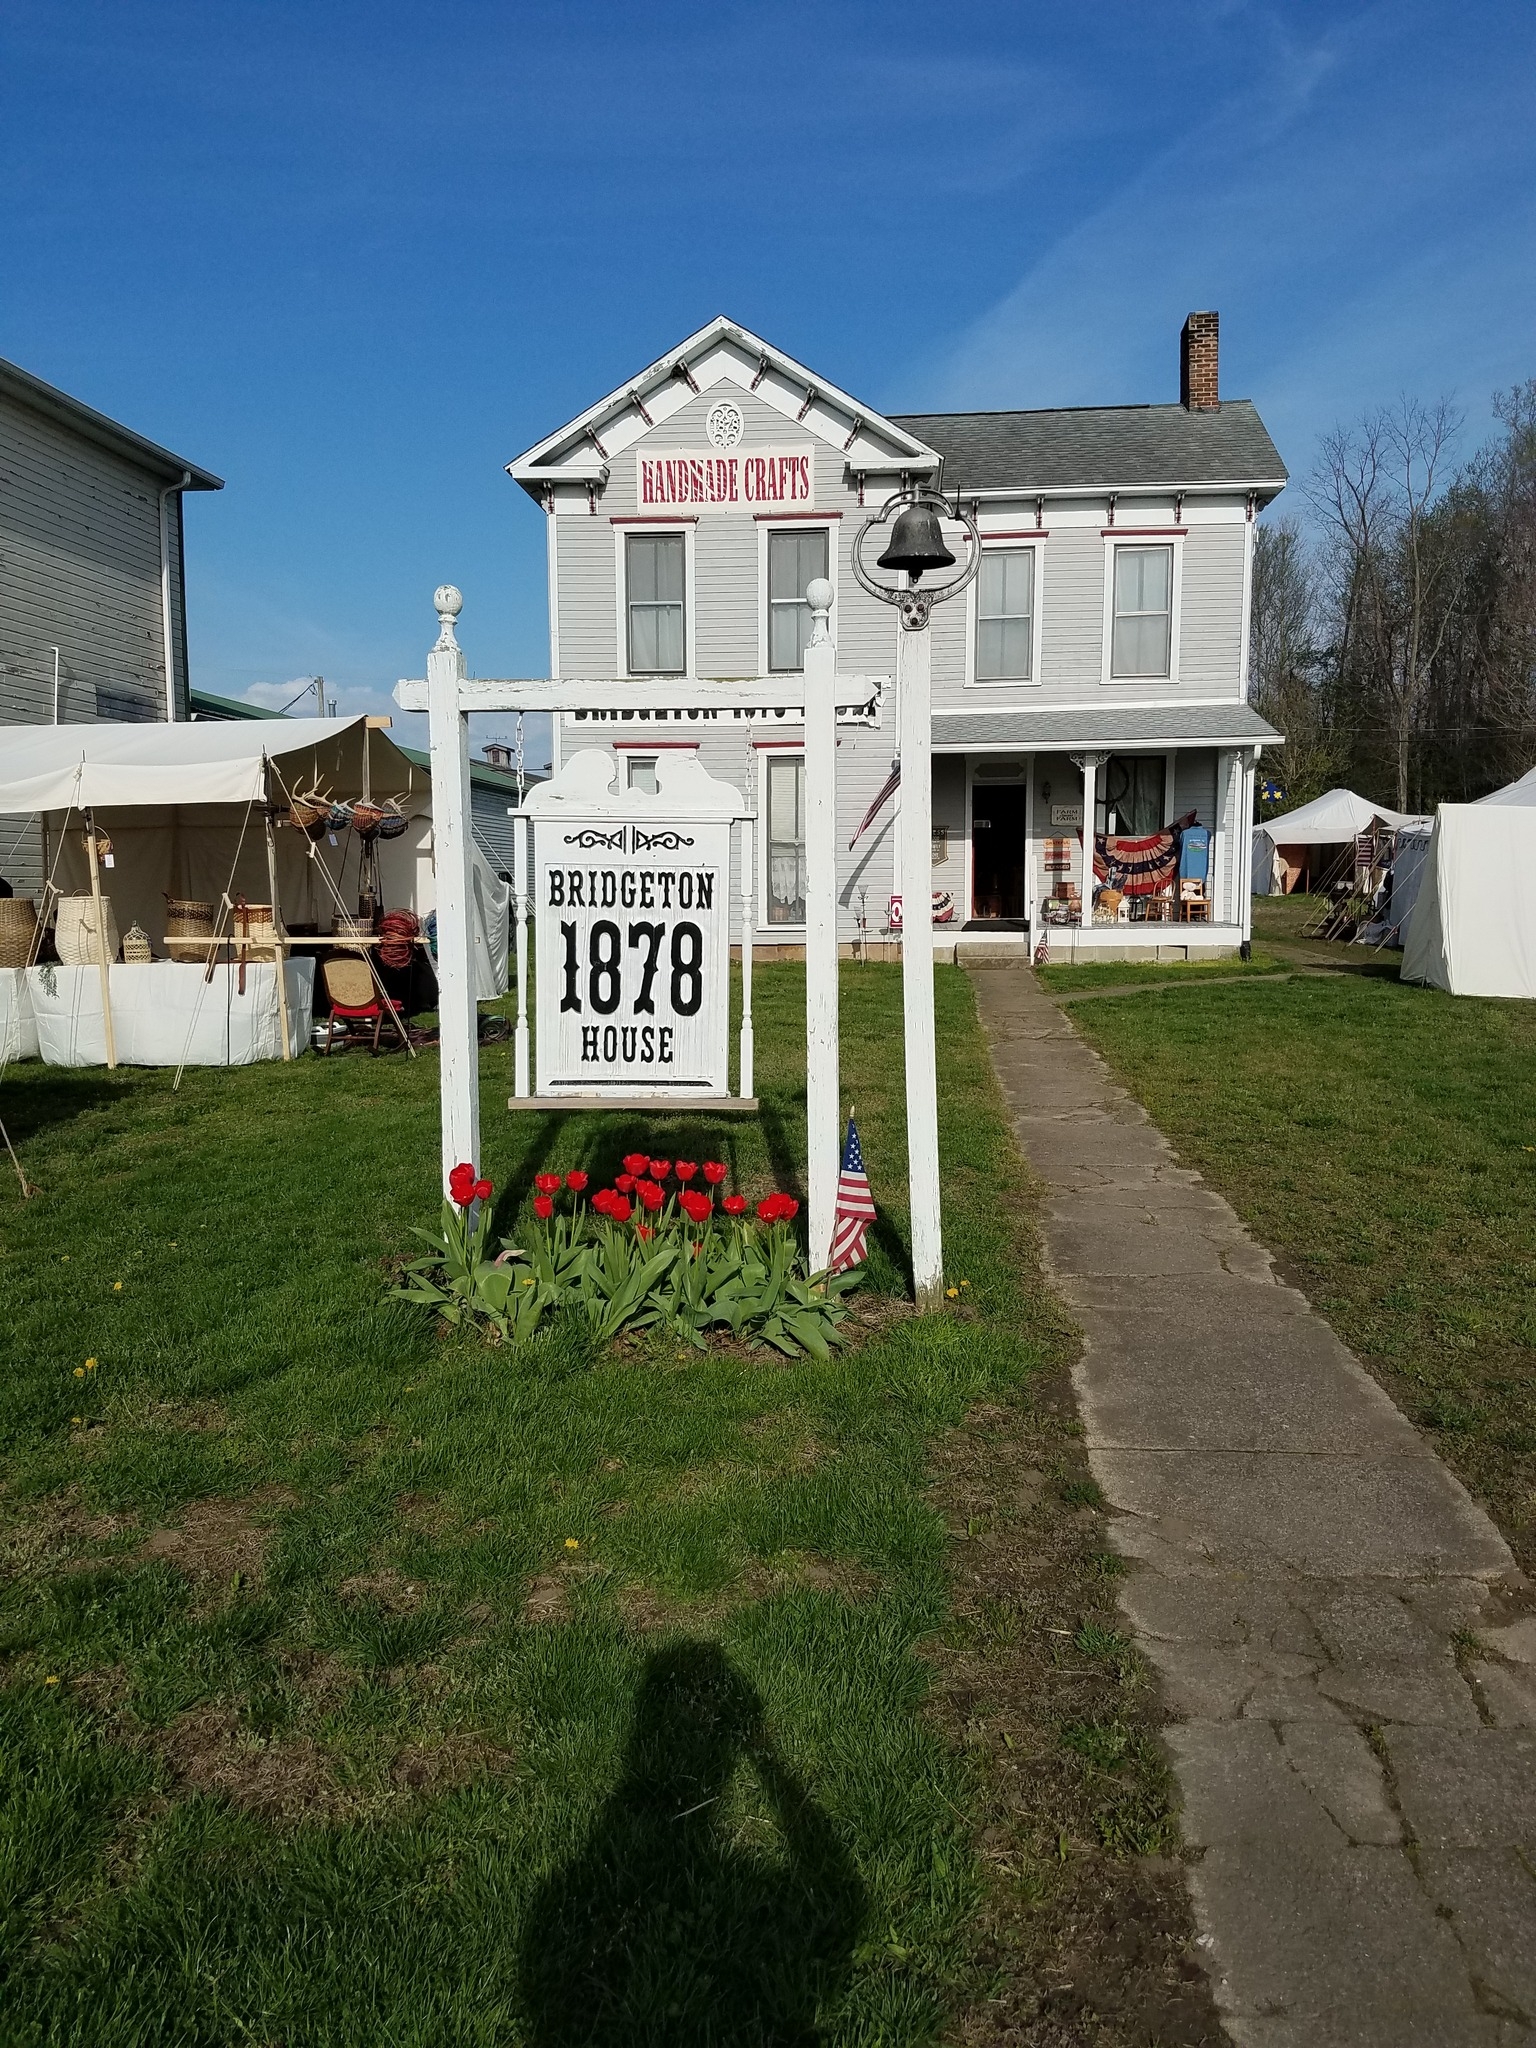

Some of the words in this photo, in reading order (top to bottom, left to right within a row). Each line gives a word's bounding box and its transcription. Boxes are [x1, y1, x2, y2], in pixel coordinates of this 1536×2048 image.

[641, 458, 738, 503] HANDMADE
[744, 456, 809, 501] CRAFTS
[549, 869, 714, 910] BRIDGETON
[560, 920, 703, 1016] 1878
[581, 1025, 673, 1063] HOUSE
